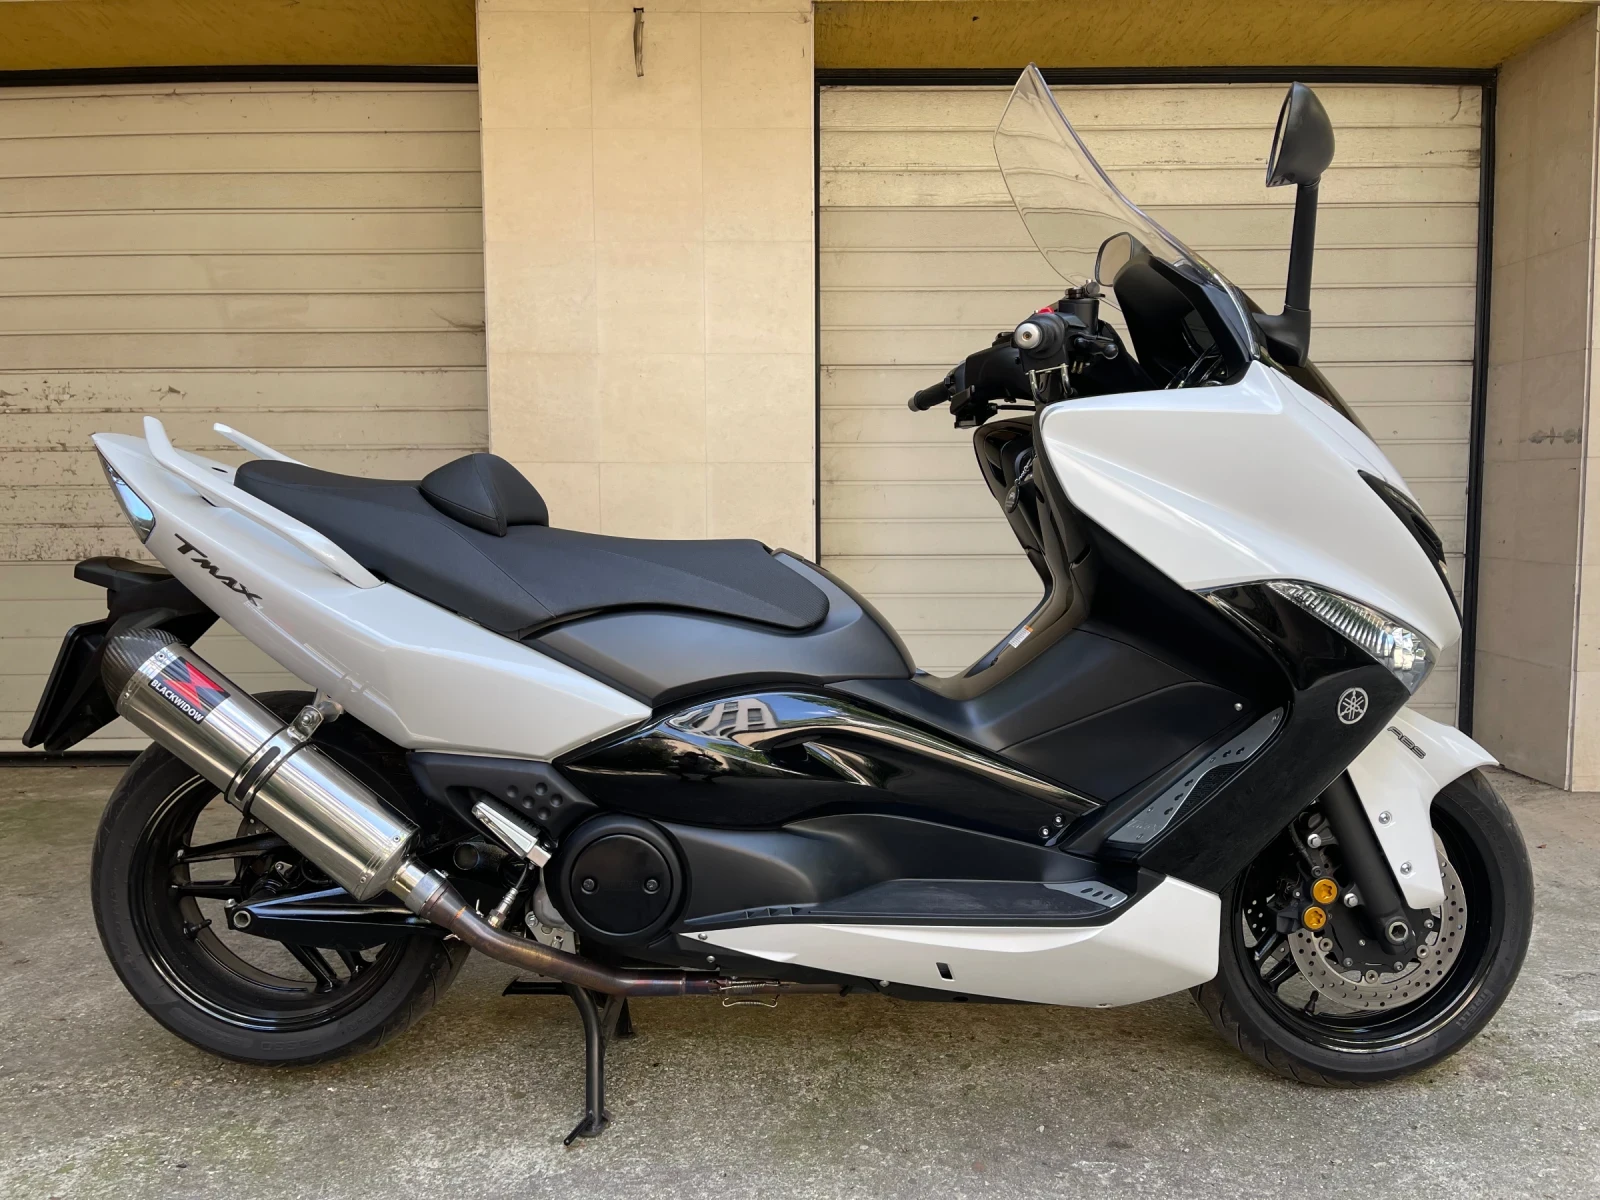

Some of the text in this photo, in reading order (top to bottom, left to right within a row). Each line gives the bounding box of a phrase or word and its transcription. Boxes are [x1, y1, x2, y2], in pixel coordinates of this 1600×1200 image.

[174, 533, 262, 606] TMAX
[150, 679, 204, 722] BLACKWIDOW
[1387, 725, 1427, 760] ABS
